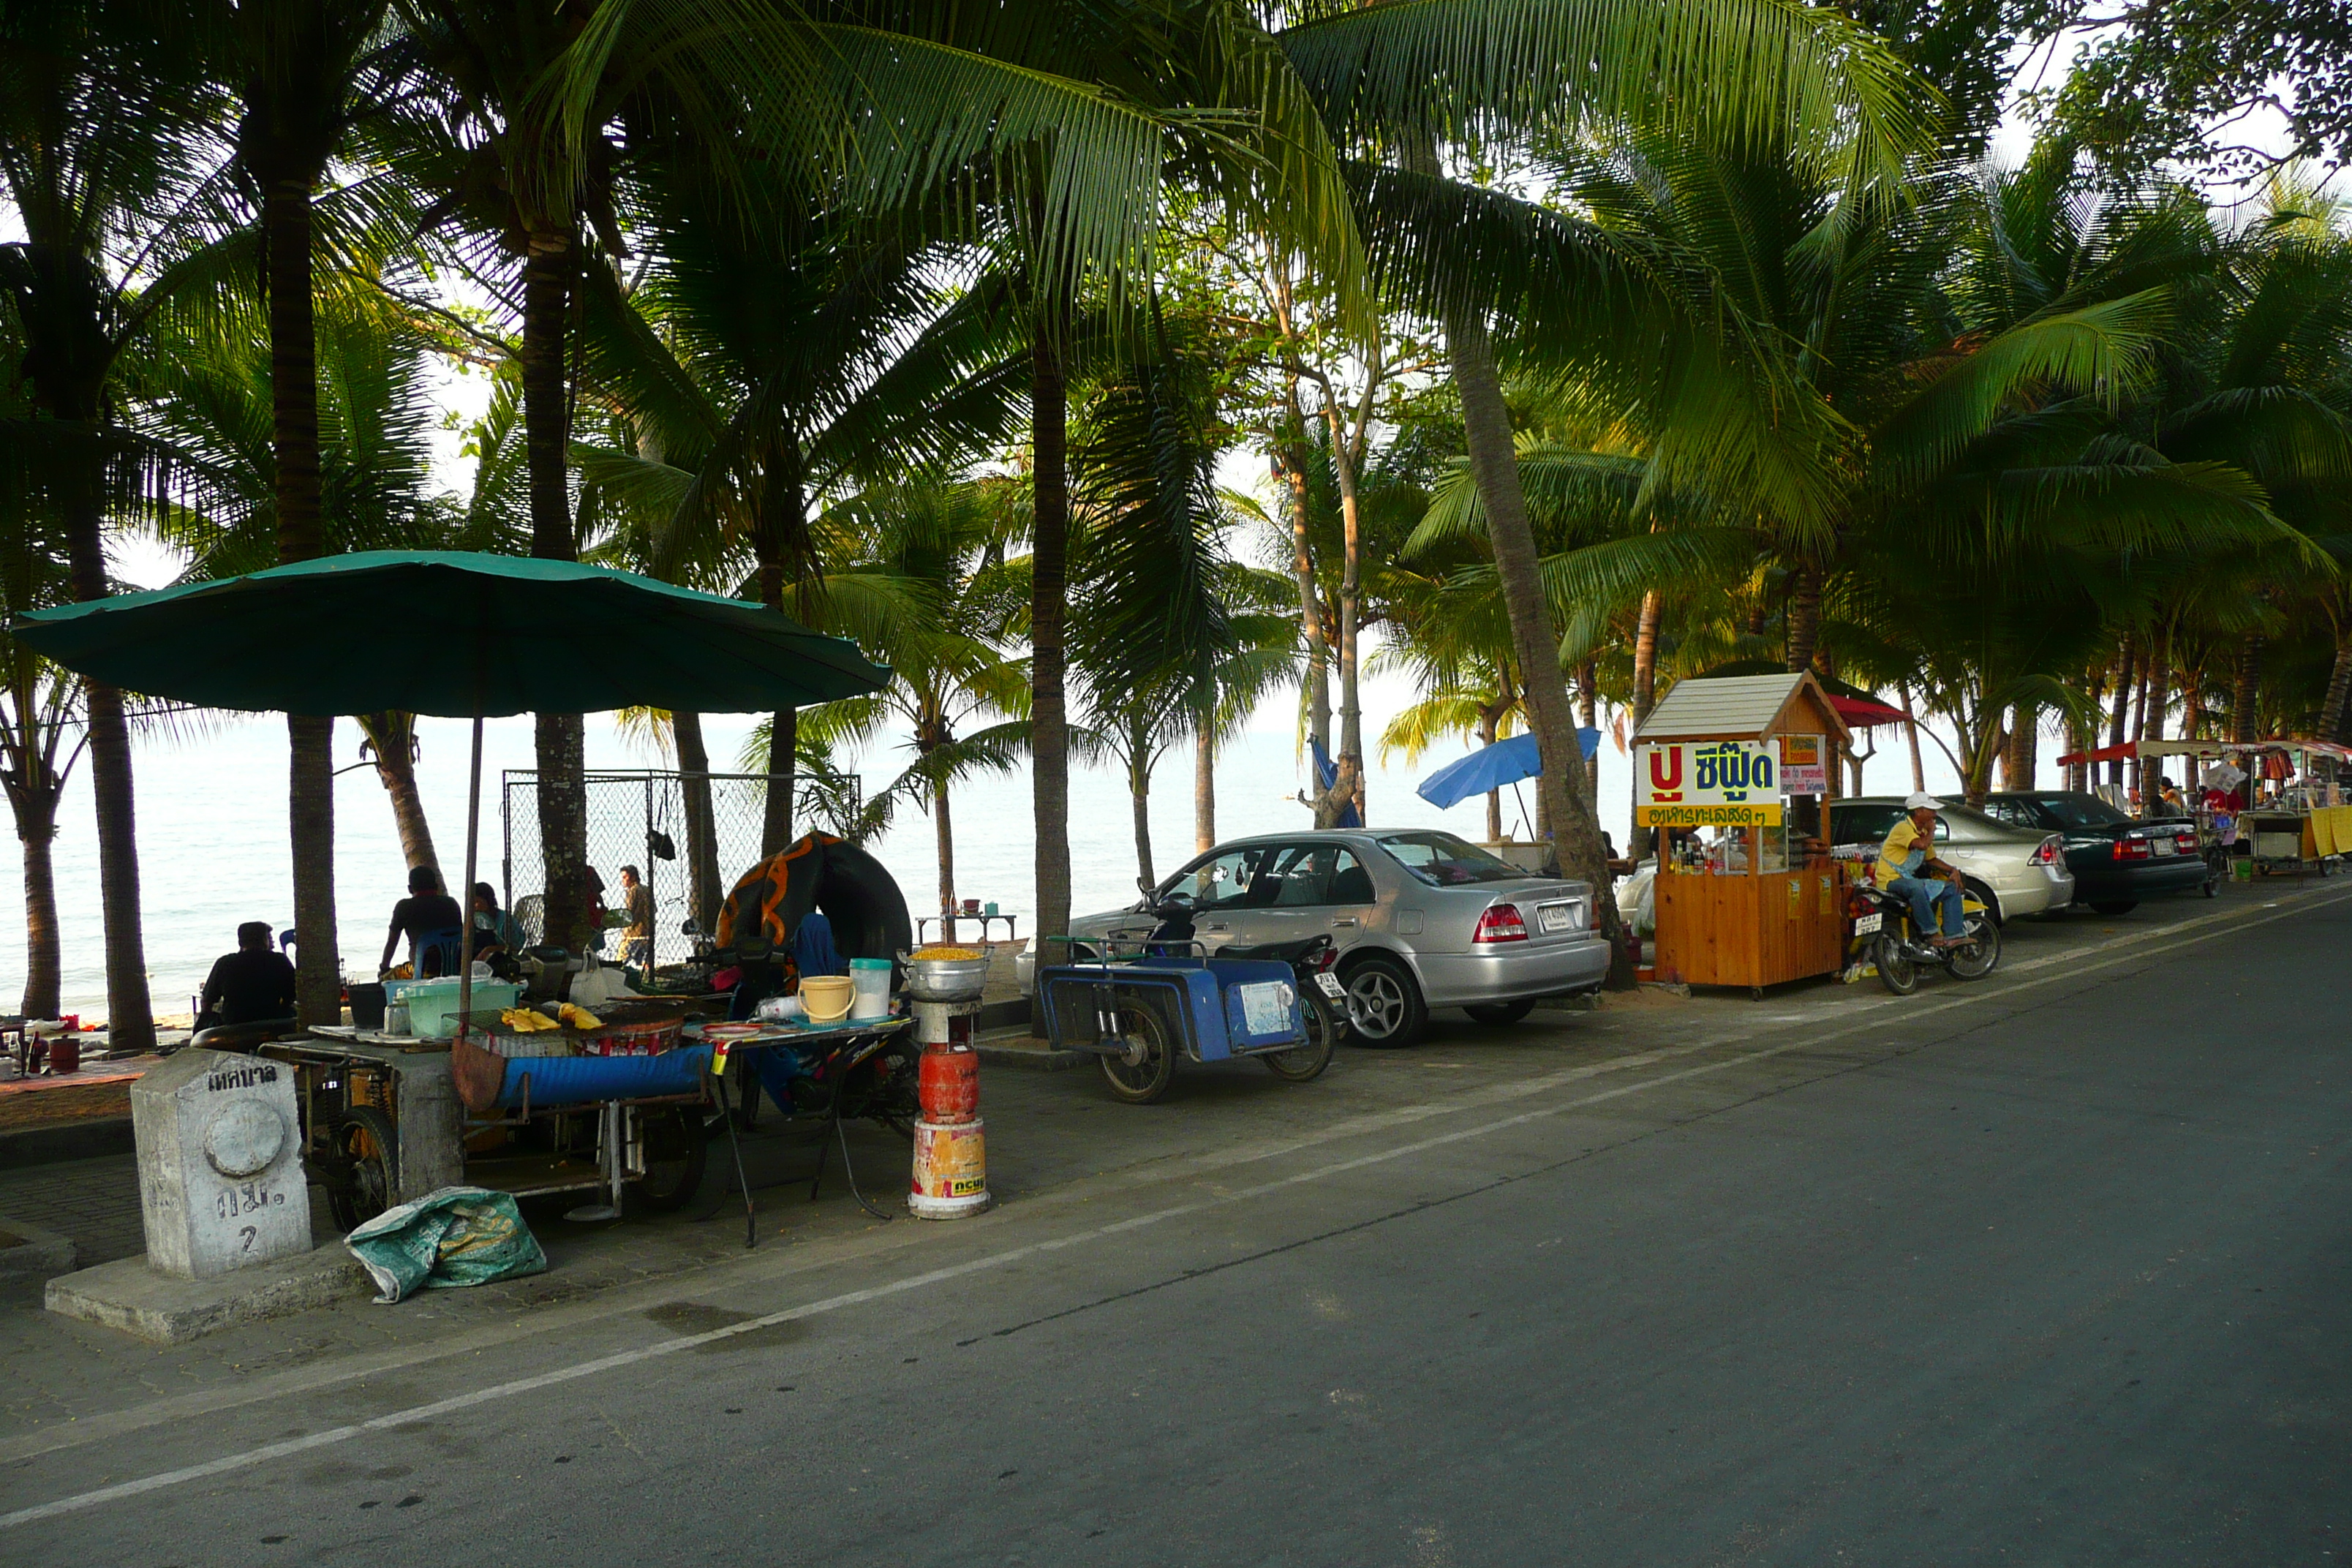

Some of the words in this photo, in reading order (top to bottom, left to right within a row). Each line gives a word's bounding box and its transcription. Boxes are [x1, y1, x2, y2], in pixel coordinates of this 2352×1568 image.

[1649, 746, 1683, 802] ปู
[1648, 807, 1752, 825] อาหารทะเลสด
[208, 1065, 278, 1092] เทศบาล
[217, 1181, 285, 1218] กม.
[238, 1225, 259, 1253] 2
